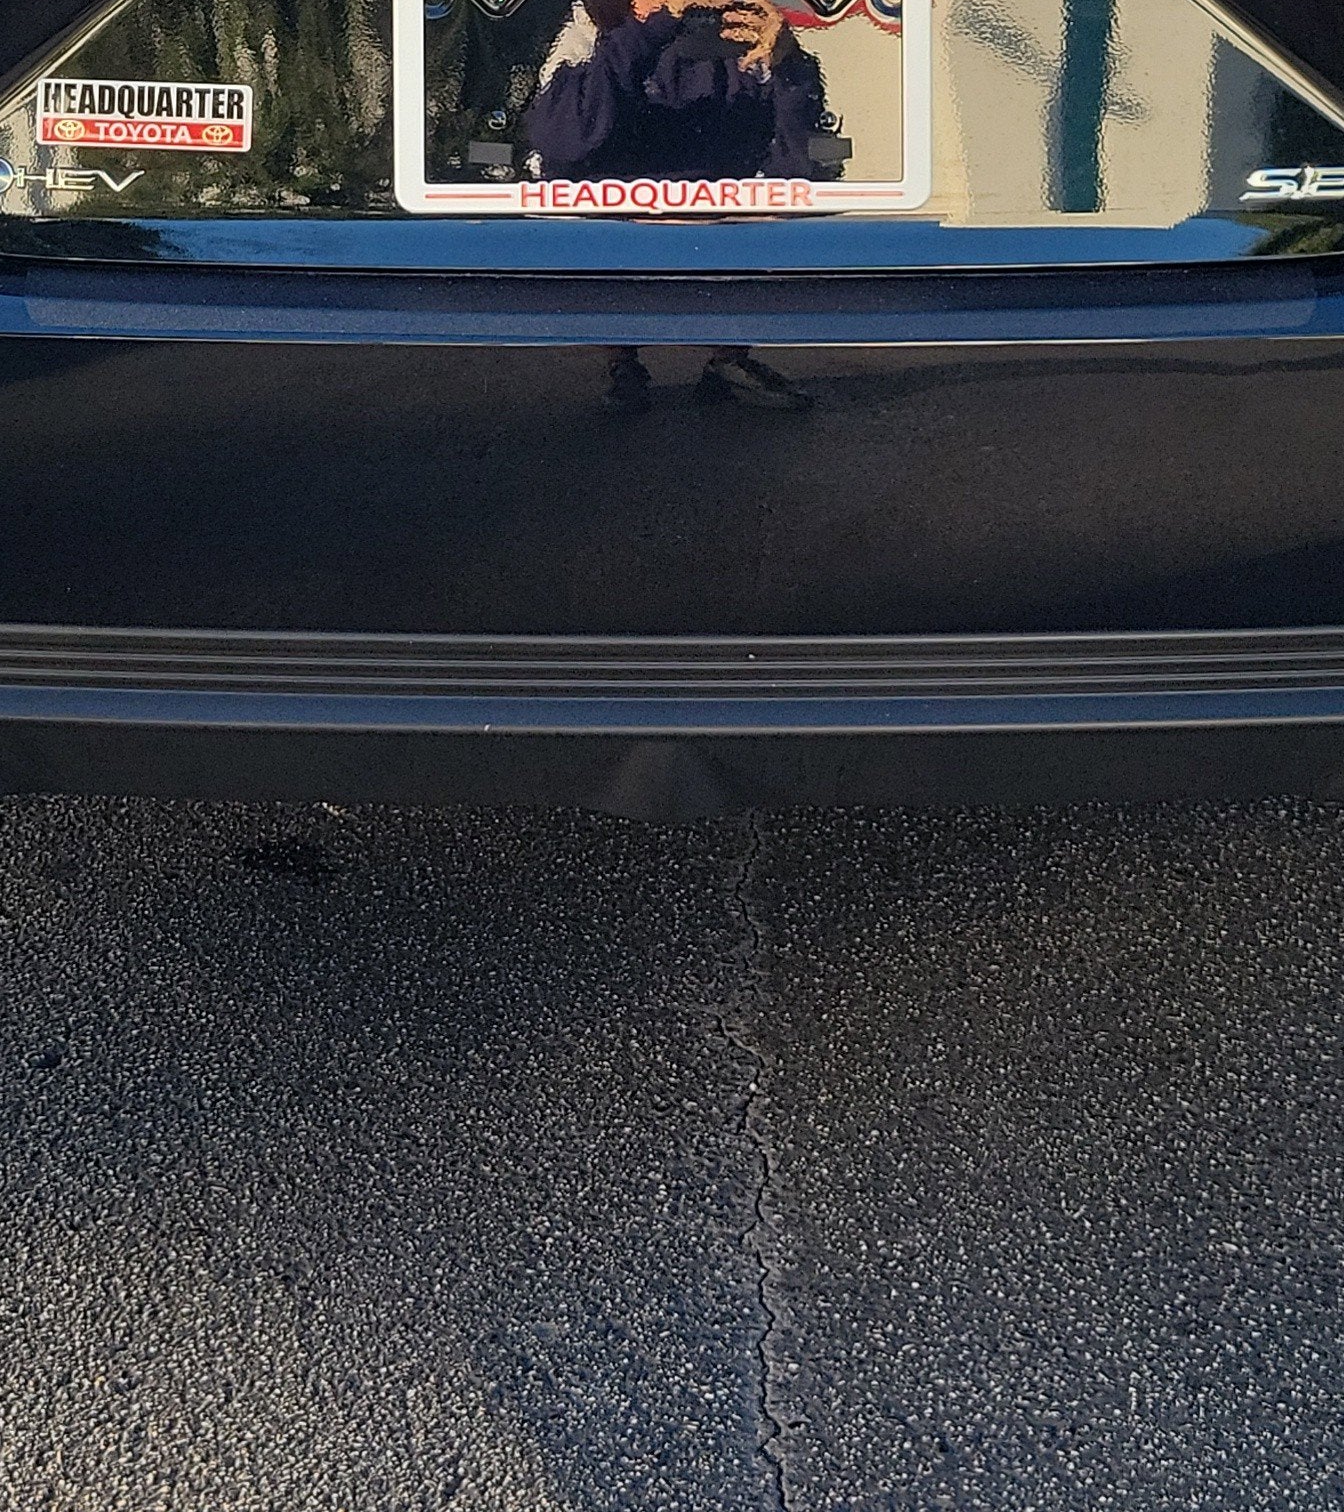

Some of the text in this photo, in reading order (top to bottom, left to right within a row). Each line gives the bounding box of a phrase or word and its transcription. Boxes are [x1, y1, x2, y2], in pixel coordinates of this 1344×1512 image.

[43, 82, 245, 120] HEADQUARTER
[94, 121, 193, 144] TOYOTA
[520, 181, 814, 210] HEADQUARTER
